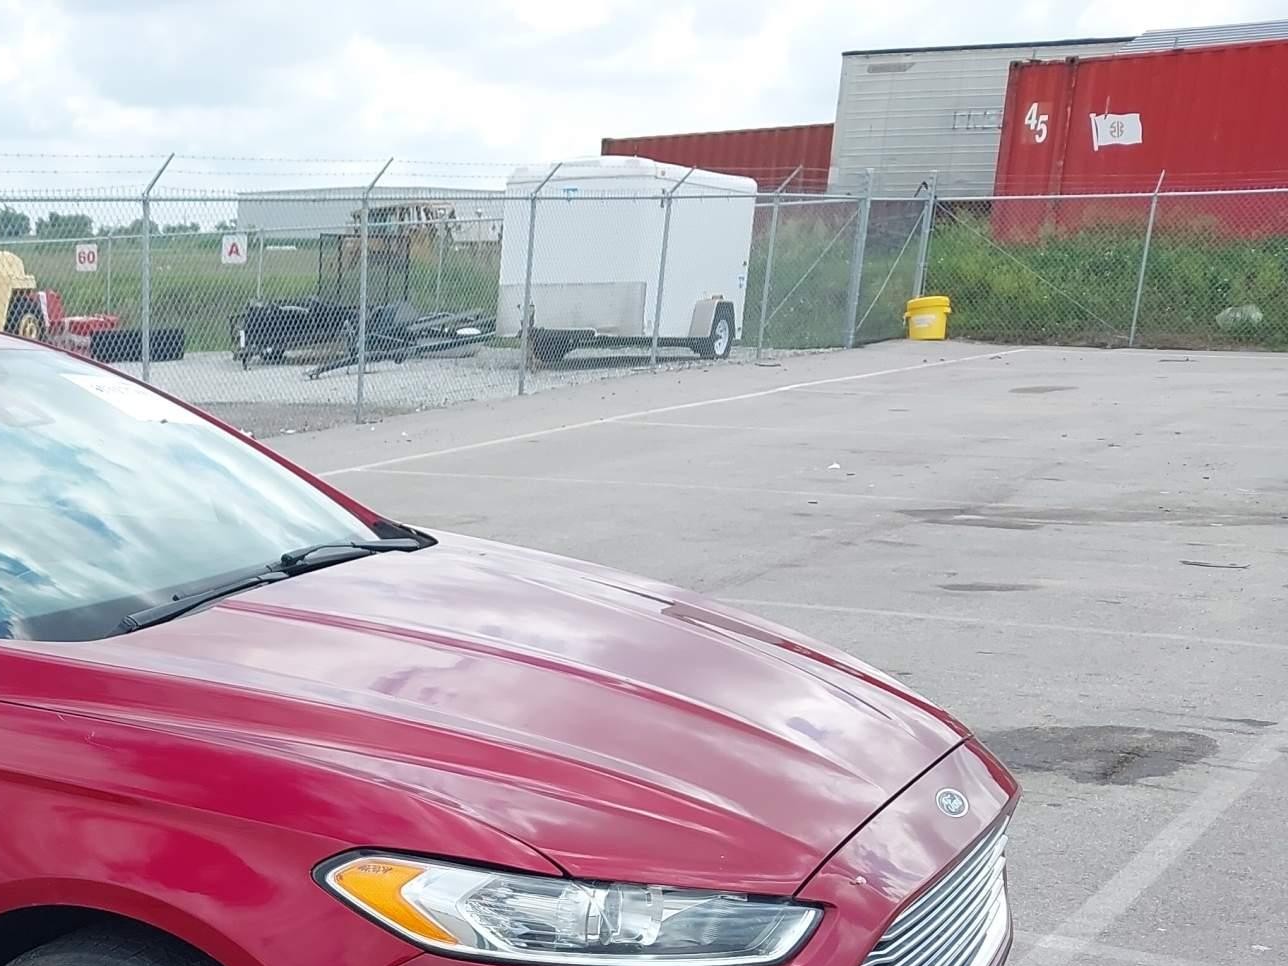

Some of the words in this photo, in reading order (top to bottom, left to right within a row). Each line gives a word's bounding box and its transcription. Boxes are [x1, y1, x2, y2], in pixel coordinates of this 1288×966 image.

[1024, 102, 1048, 143] 45
[228, 242, 241, 257] A
[78, 250, 96, 265] 60
